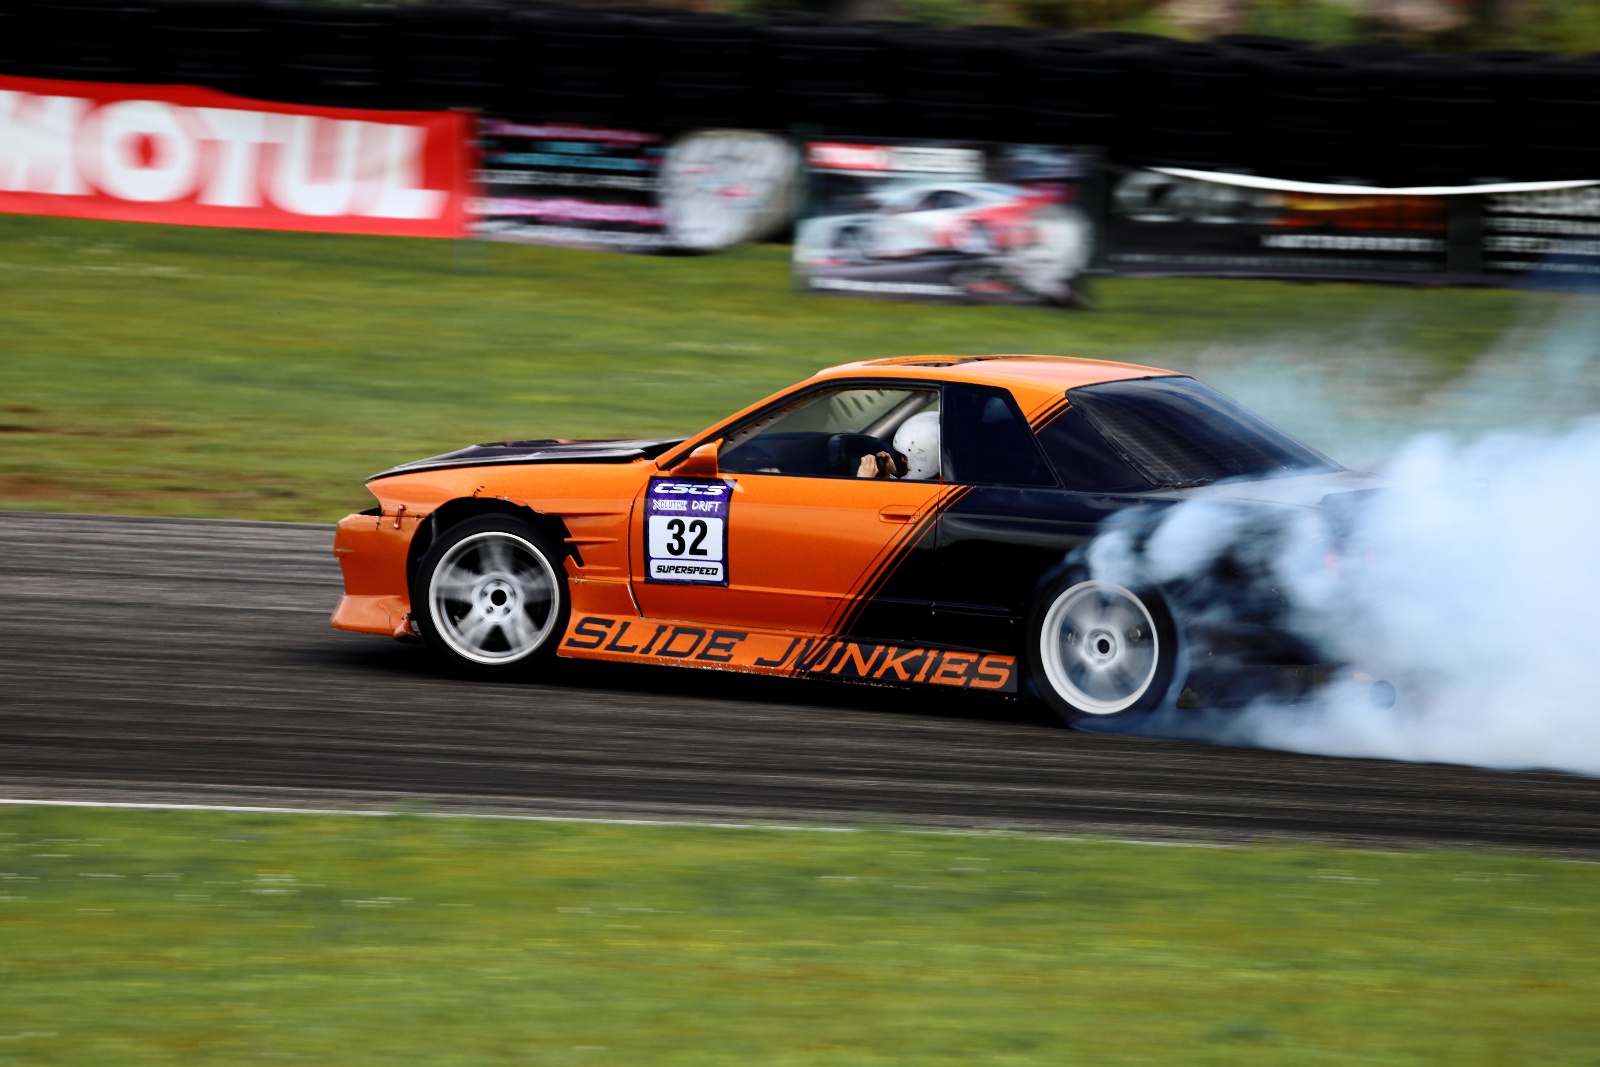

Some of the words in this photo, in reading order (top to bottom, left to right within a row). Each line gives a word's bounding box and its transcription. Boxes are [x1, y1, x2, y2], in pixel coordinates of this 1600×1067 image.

[0, 90, 449, 218] MOTUL
[654, 483, 726, 495] CSCS
[692, 501, 721, 512] DRIFT
[666, 518, 708, 556] 32
[656, 566, 718, 575] SUPERSPEED
[566, 617, 746, 660] SLIDE
[754, 638, 1015, 688] JUNKIES
